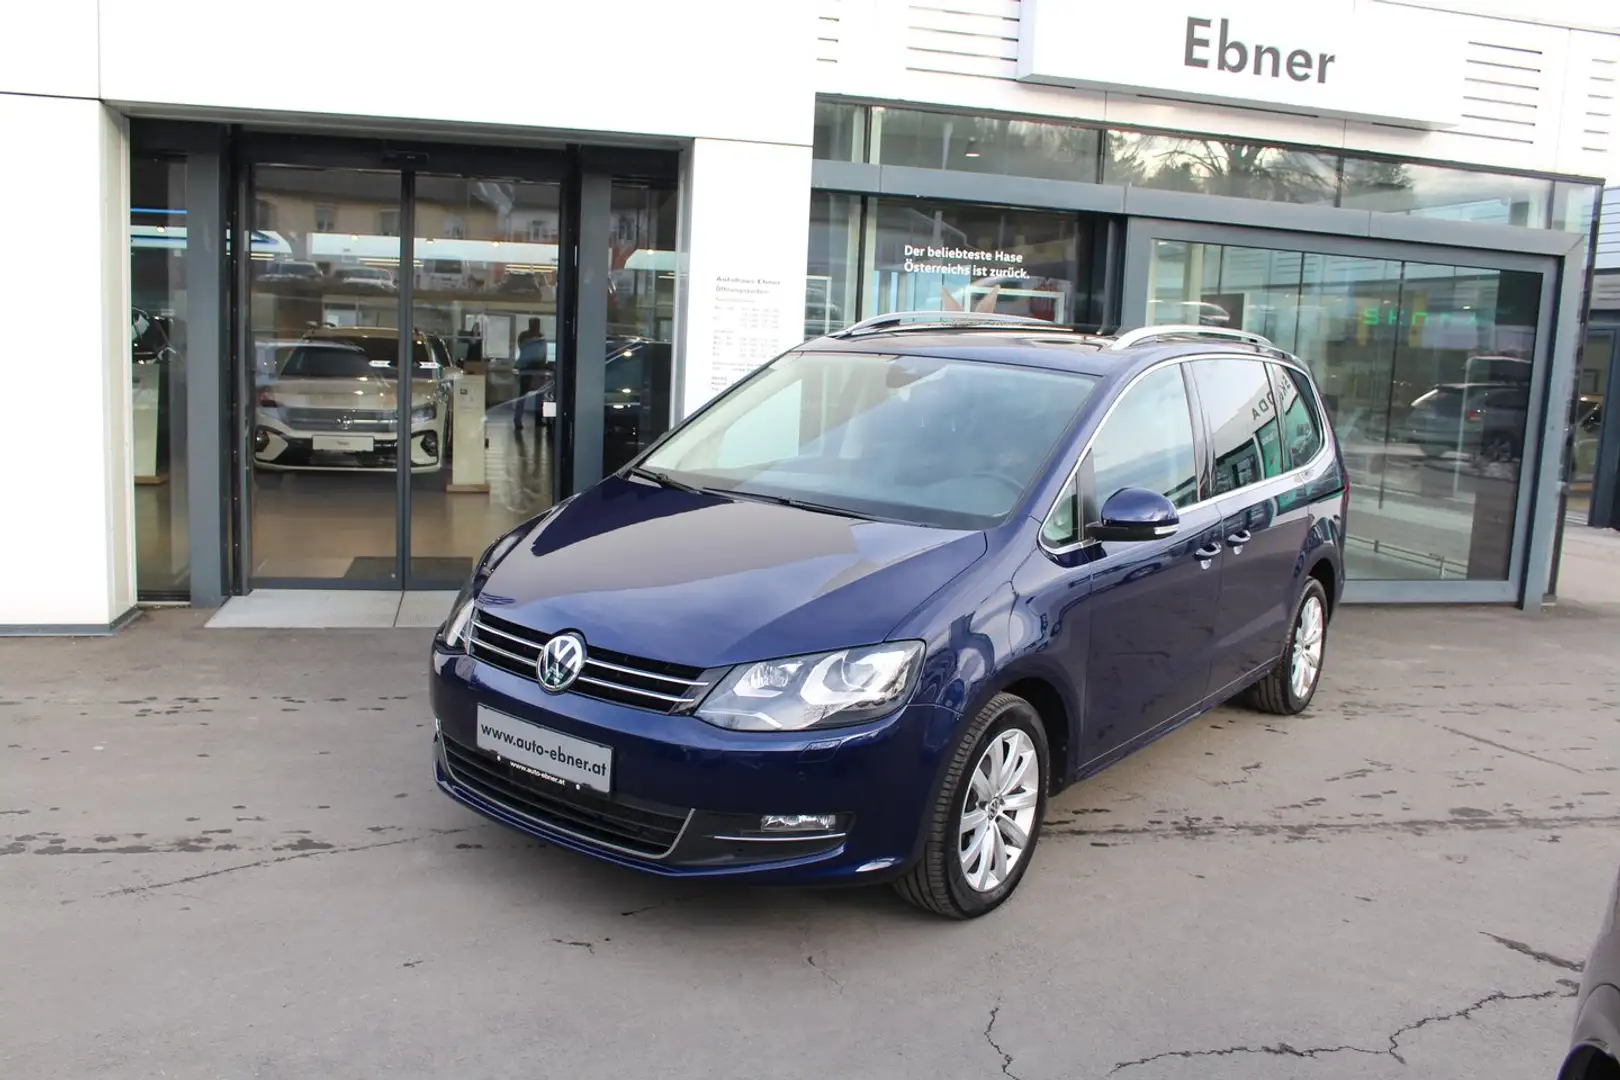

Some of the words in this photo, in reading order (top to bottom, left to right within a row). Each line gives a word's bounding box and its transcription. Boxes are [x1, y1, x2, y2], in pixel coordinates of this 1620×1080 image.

[1184, 16, 1335, 84] Ebner
[904, 245, 924, 257] Der
[928, 246, 993, 261] beliebteste
[995, 250, 1023, 263] Hase
[904, 258, 970, 276] Österreichs
[973, 265, 987, 277] ist
[989, 267, 1030, 279] zurück.
[481, 723, 606, 777] www.auto-ebner.at
[510, 761, 566, 786] www.auto-ebner.at
